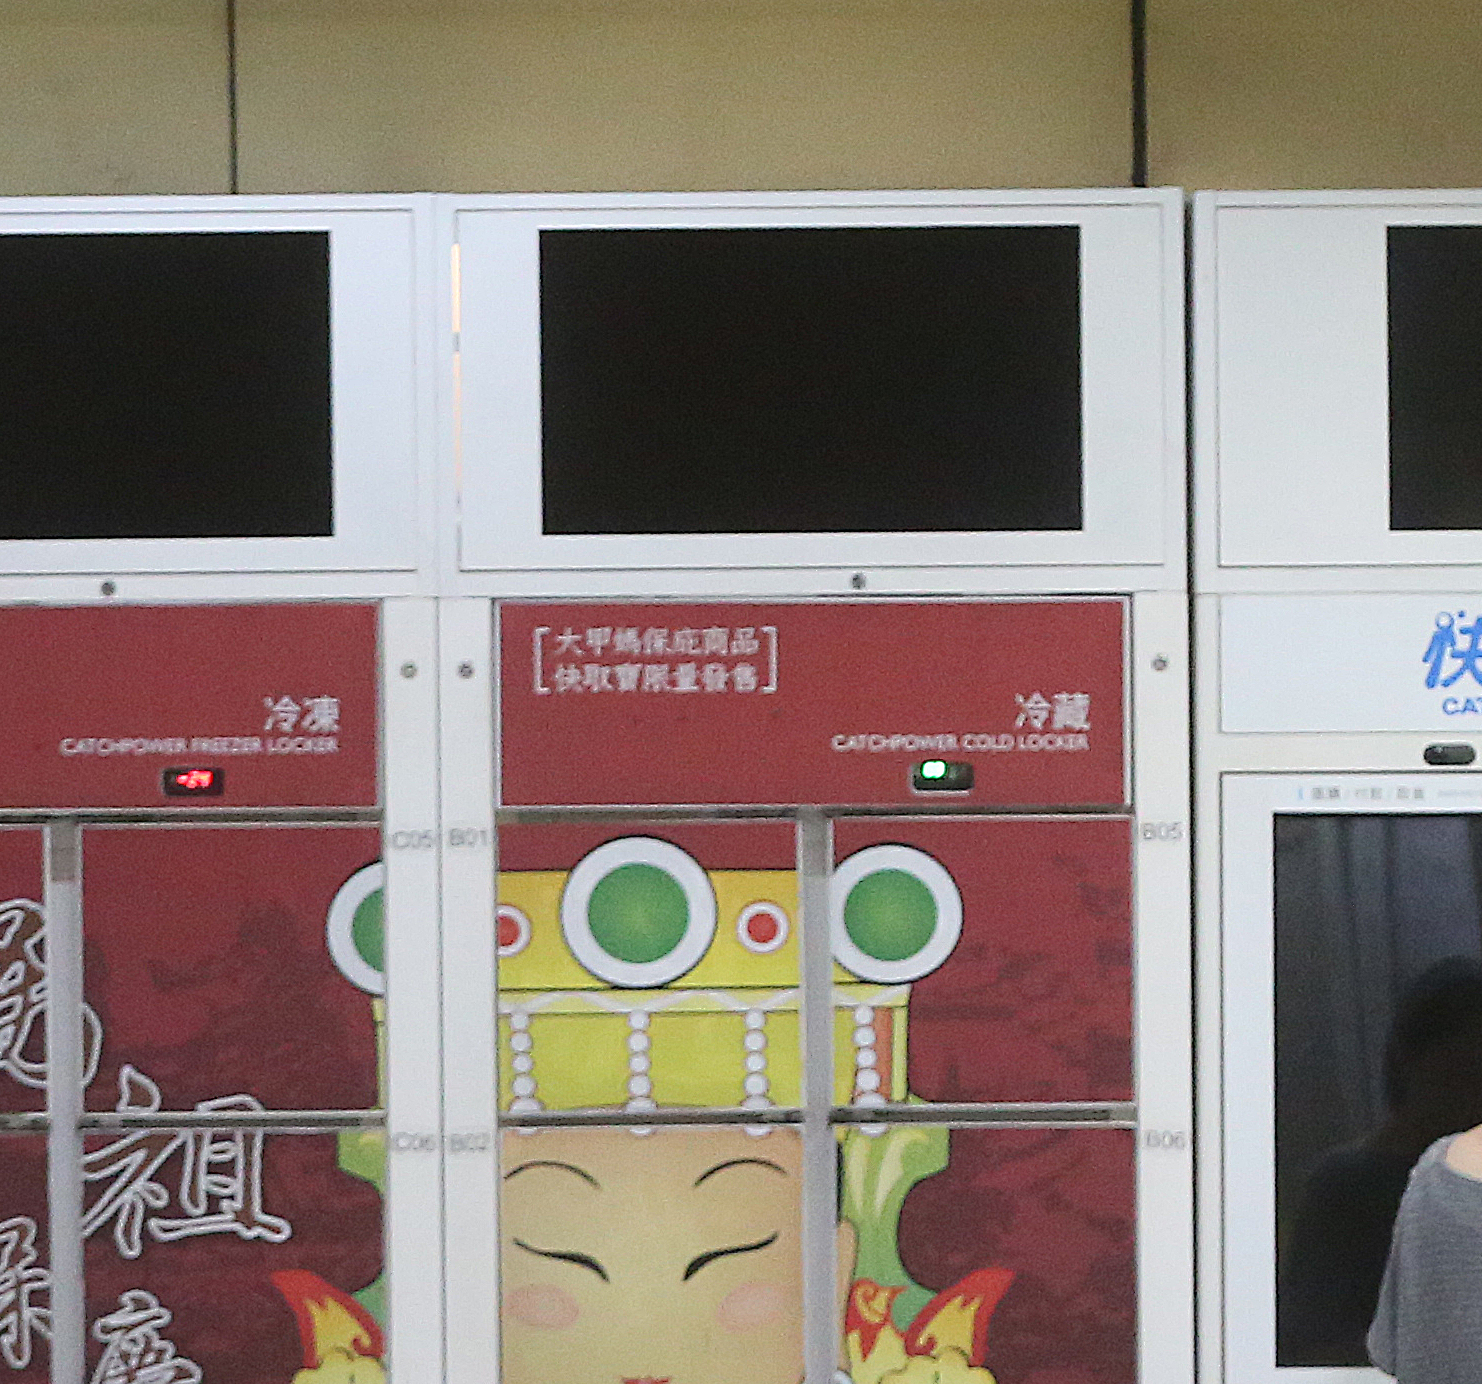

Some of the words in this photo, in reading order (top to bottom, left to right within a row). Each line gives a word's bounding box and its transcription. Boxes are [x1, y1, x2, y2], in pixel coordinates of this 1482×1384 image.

[553, 662, 758, 693] 快取寶限量發售
[264, 695, 340, 732] 冷凍
[1015, 692, 1090, 730] 冷藏
[60, 738, 188, 755] CATCHPOWER
[191, 738, 261, 755] FREEZER
[268, 737, 339, 754] LOCKER
[830, 734, 958, 752] CATCHPOWER
[961, 733, 1014, 751] COLD
[1018, 733, 1089, 751] LOCKER
